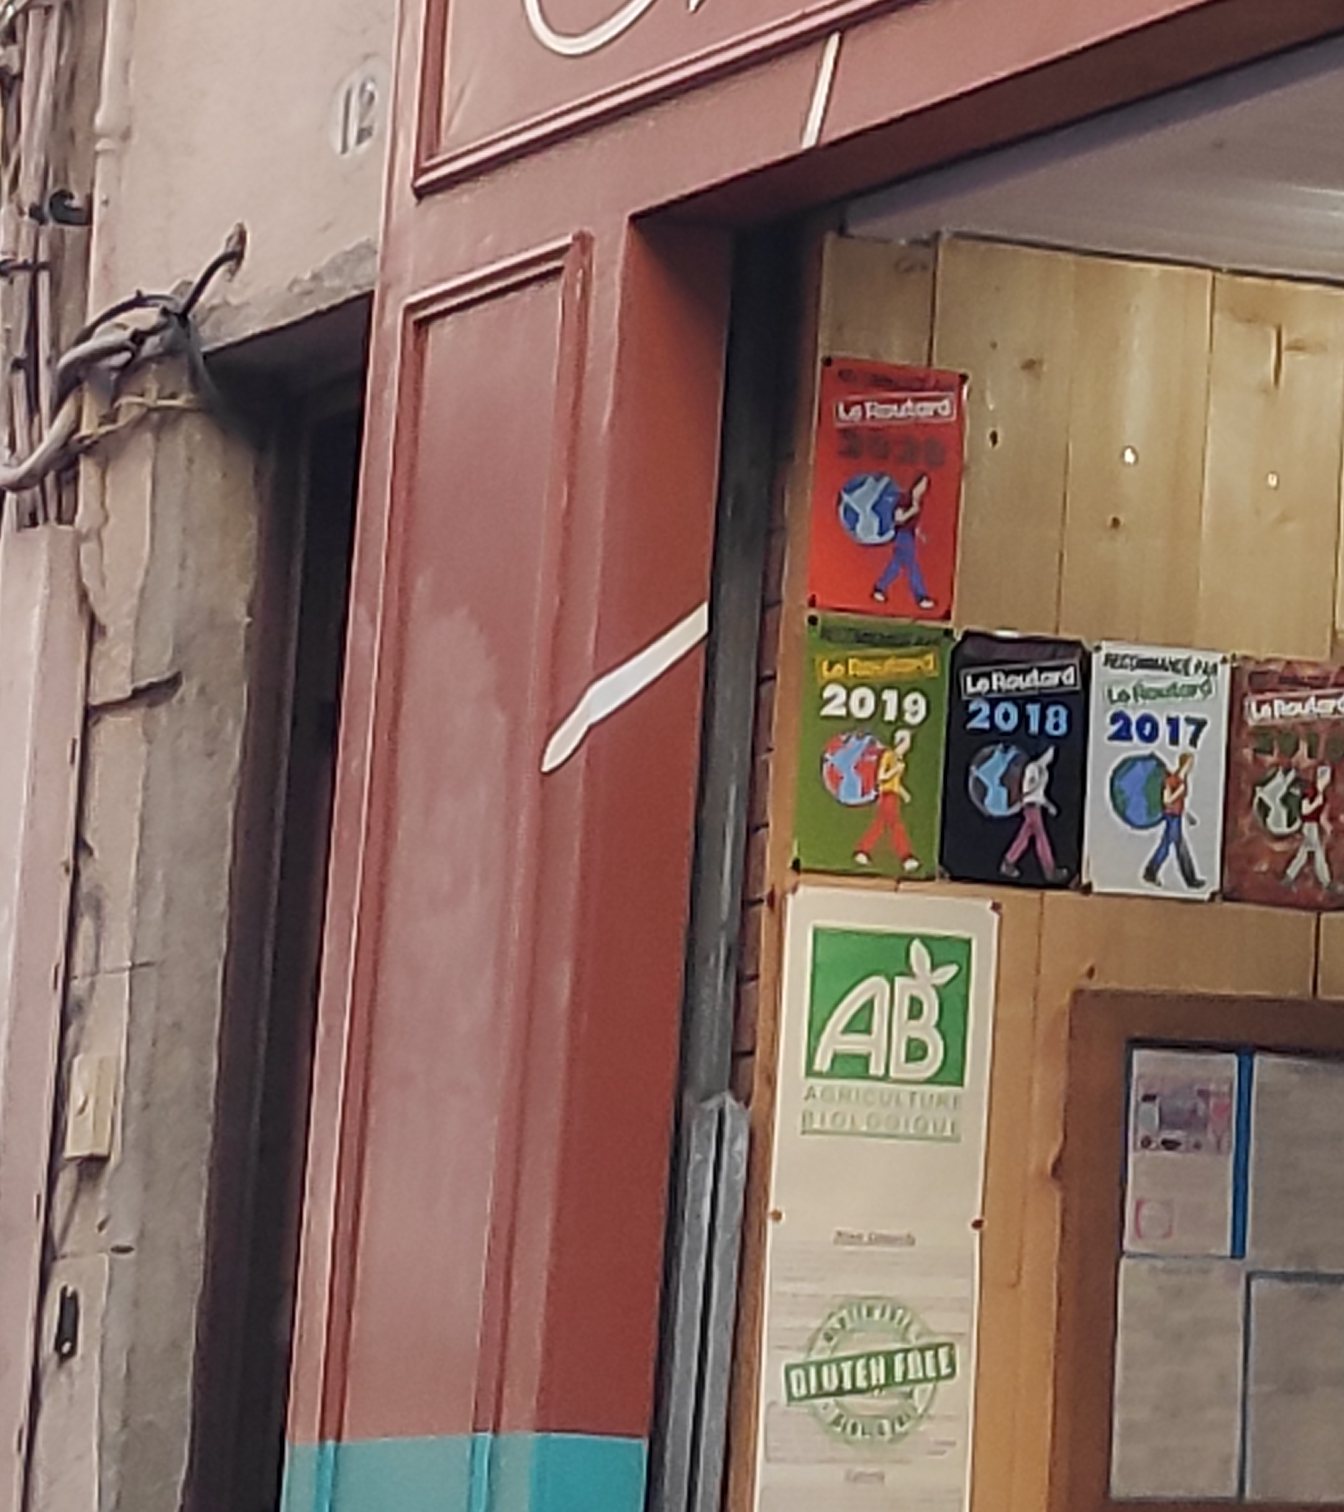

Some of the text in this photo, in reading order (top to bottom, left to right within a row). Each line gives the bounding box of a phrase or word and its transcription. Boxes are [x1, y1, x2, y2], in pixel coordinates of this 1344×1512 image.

[339, 74, 378, 155] 12
[966, 665, 1076, 694] Le Routard
[819, 682, 928, 726] 2019
[965, 698, 1070, 737] 2018
[1106, 710, 1209, 749] 2017
[813, 975, 945, 1082] AB
[789, 1345, 954, 1399] GLUTEN FREE
